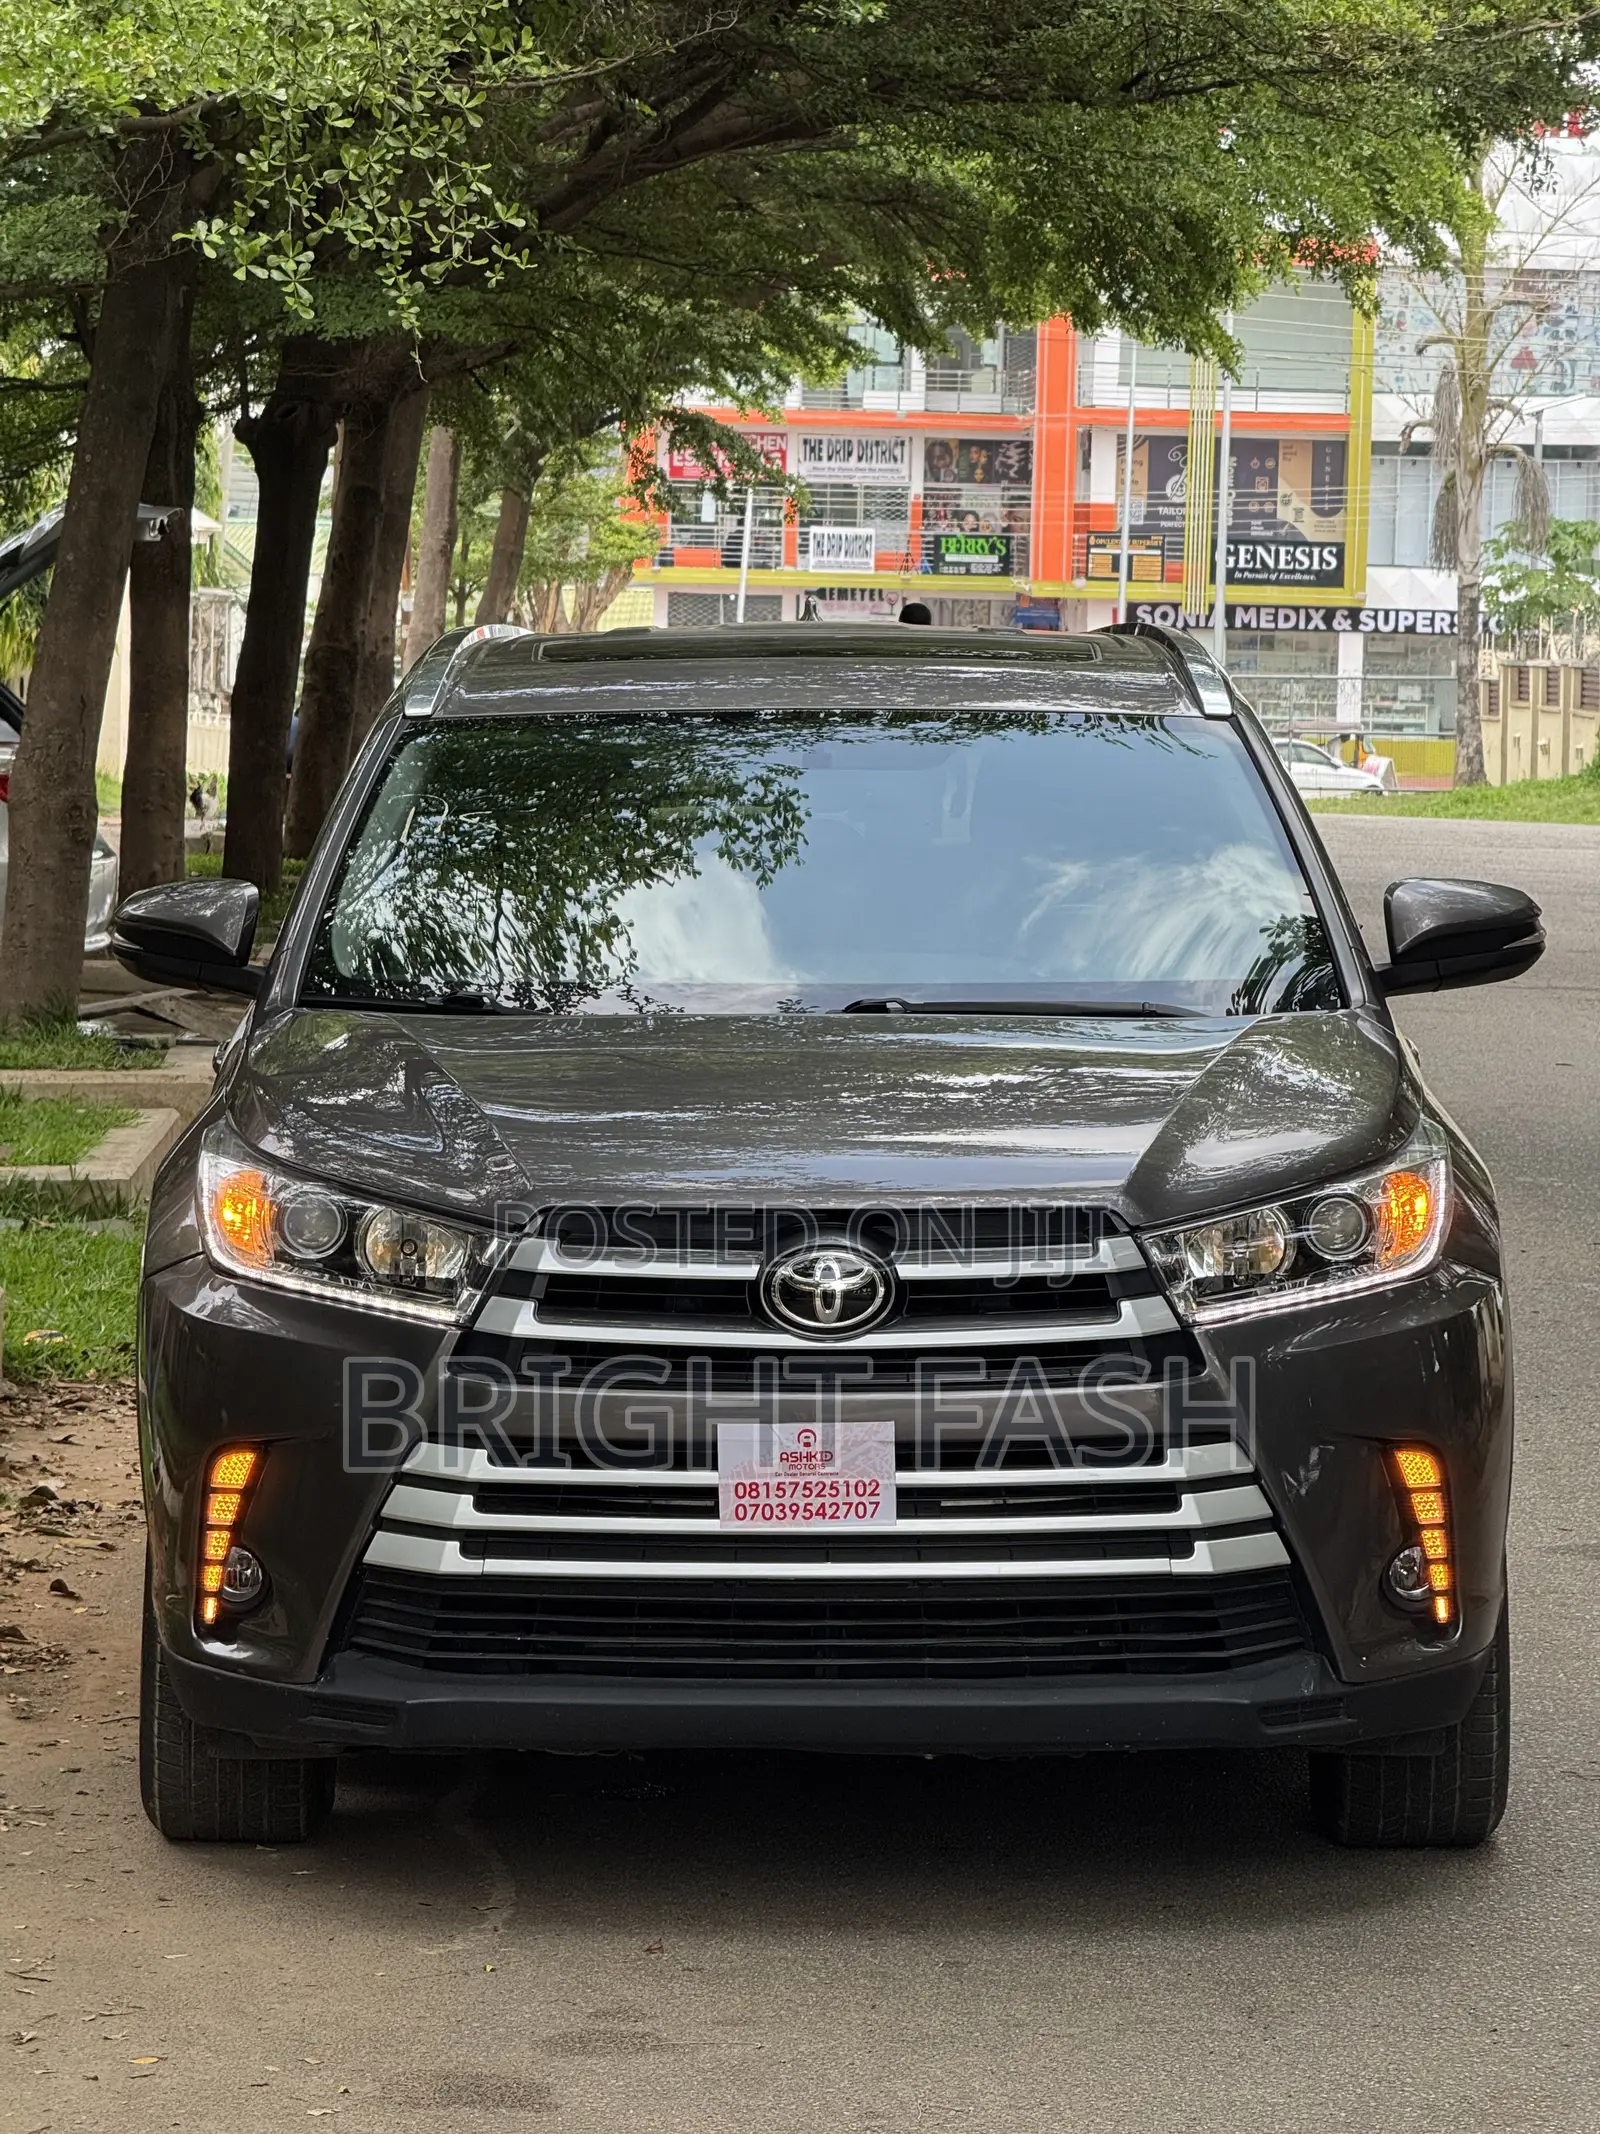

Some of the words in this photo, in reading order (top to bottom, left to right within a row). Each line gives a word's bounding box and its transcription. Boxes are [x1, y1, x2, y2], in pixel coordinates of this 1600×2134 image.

[802, 438, 823, 462] THE
[827, 438, 853, 463] DRIP
[857, 438, 905, 465] DISTRICT
[940, 535, 1007, 556] BERRY'S
[1215, 544, 1338, 571] GENESIS
[1234, 570, 1242, 579] In
[1243, 571, 1268, 580] Pursuit
[1269, 571, 1277, 581] of
[1235, 607, 1327, 631] MEDIX
[1332, 609, 1352, 631] &
[780, 1451, 833, 1463] ASHKID
[734, 1479, 880, 1499] 08157525102
[734, 1502, 880, 1521] 07039542707
